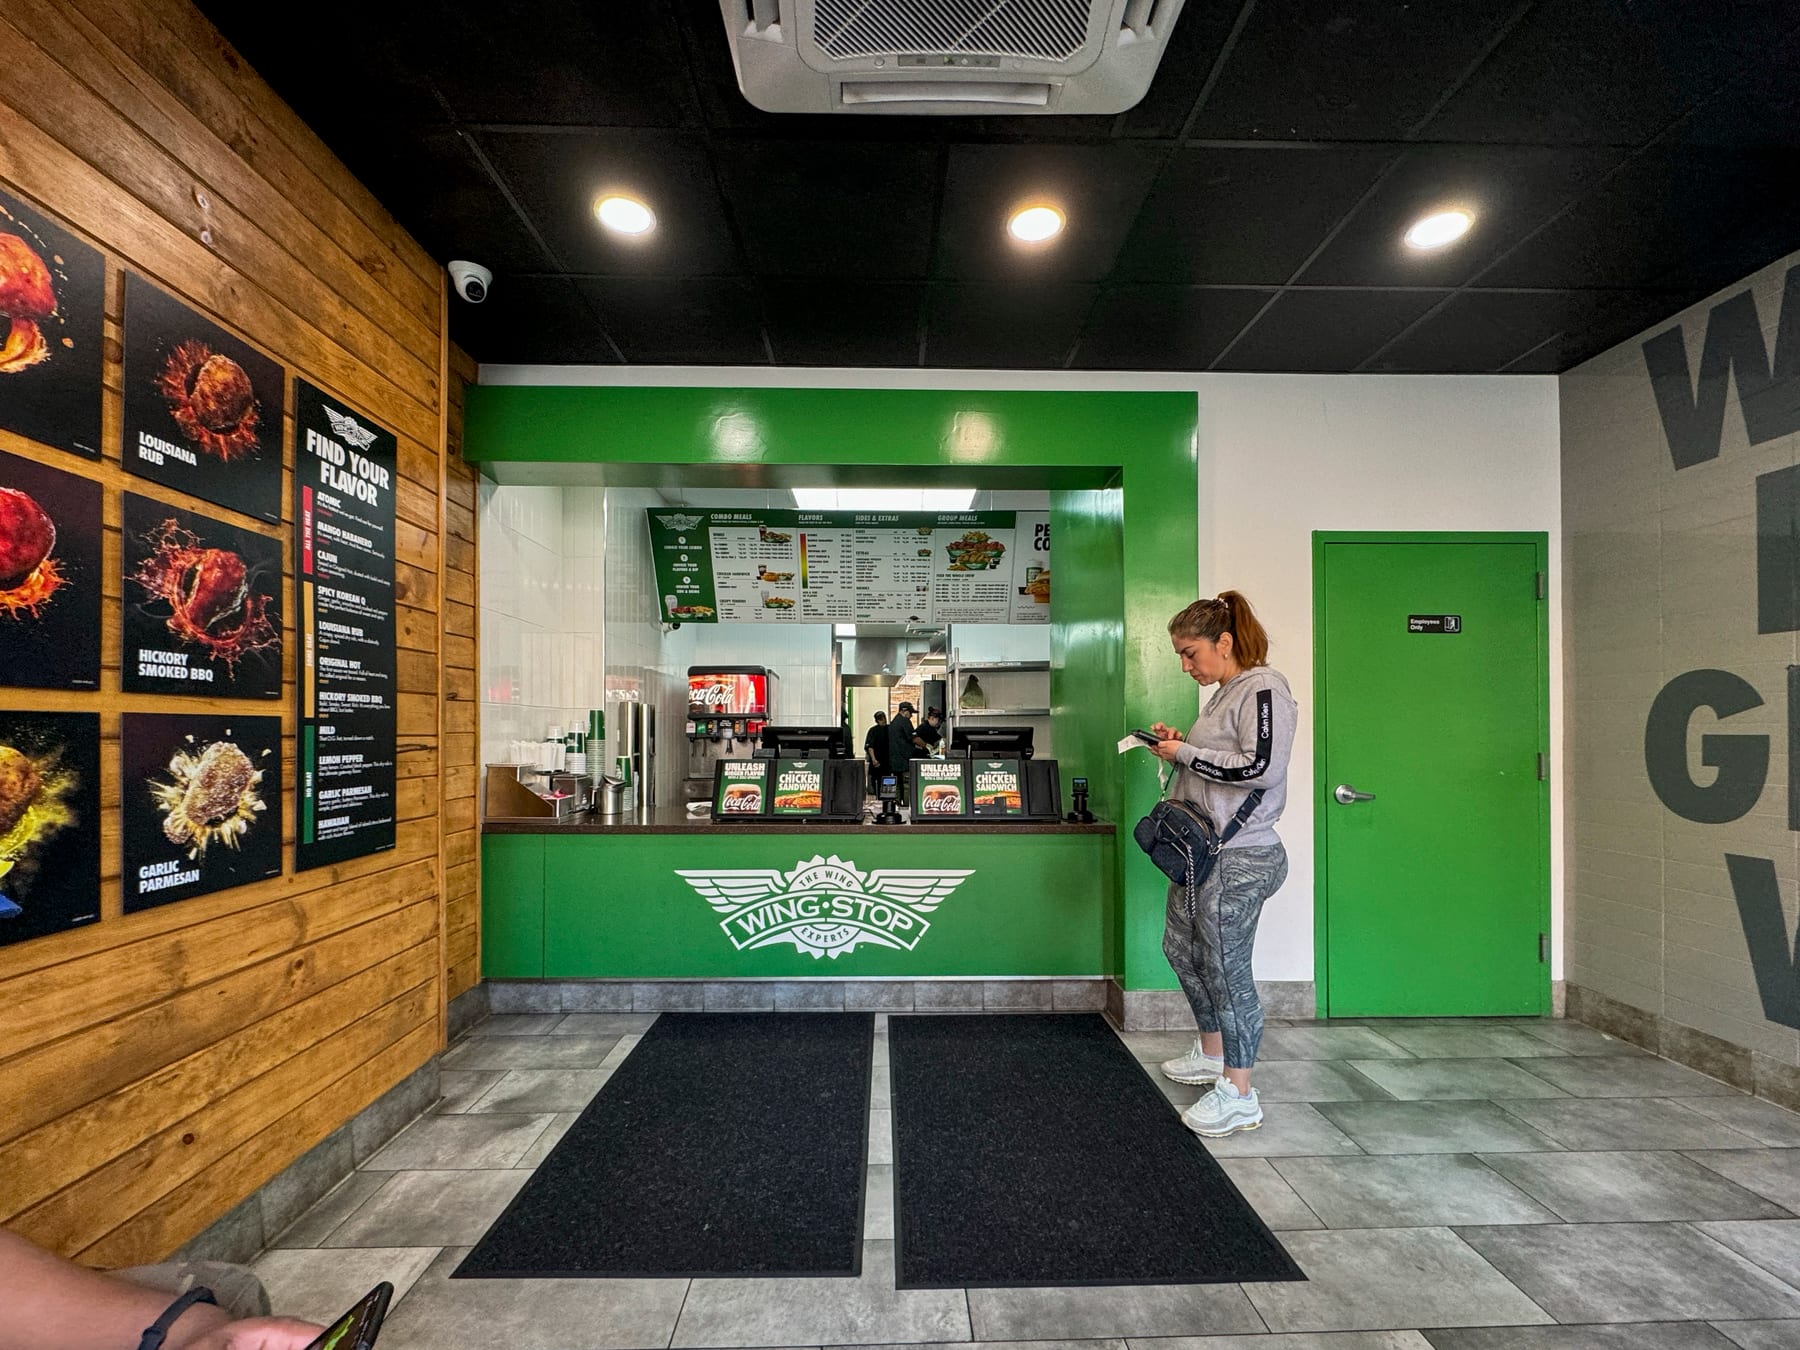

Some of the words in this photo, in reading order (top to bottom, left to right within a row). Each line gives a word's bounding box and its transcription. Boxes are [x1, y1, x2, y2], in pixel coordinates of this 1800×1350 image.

[138, 431, 197, 466] LOUISIANA
[138, 446, 164, 466] RUB
[306, 428, 346, 466] FIND
[348, 450, 389, 490] YOUR
[320, 460, 378, 507] FLAVOR
[317, 490, 341, 508] ATOMIC
[318, 521, 340, 537] MANGO
[342, 530, 372, 548] HABANERO
[317, 550, 338, 564] CAJUN
[318, 585, 336, 597] SPICY
[336, 590, 360, 604] KOREAN
[360, 596, 366, 606] Q
[319, 620, 350, 634] LOUISIANA
[351, 627, 364, 637] RUB
[1410, 618, 1440, 626] Employees
[138, 650, 188, 666] HICKORY
[320, 656, 348, 668] ORIGINAL
[349, 660, 361, 669] HOT
[138, 663, 188, 680] SMOKED
[190, 668, 214, 682] BBQ
[318, 692, 346, 701] HICKORY
[347, 693, 370, 702] SMOKED
[371, 695, 382, 704] BBQ
[688, 684, 735, 706] oca-Cola
[318, 726, 336, 734] MILD
[1261, 719, 1269, 738] Calvin
[319, 756, 340, 764] LEMON
[342, 754, 364, 764] PEPPER
[724, 762, 766, 770] UNLEASH
[920, 764, 961, 772] UNLEASH
[778, 783, 820, 791] SANDWICH
[779, 774, 820, 784] CHICKEN
[976, 774, 1016, 784] CHICKEN
[318, 788, 341, 800] GARLIC
[342, 786, 372, 796] PARMESAN
[976, 784, 1017, 792] SANDWICH
[139, 860, 180, 878] GARLIC
[139, 869, 200, 894] PARMESAN
[799, 871, 819, 888] THE
[825, 870, 854, 888] WING
[801, 927, 850, 944] EXPERTS
